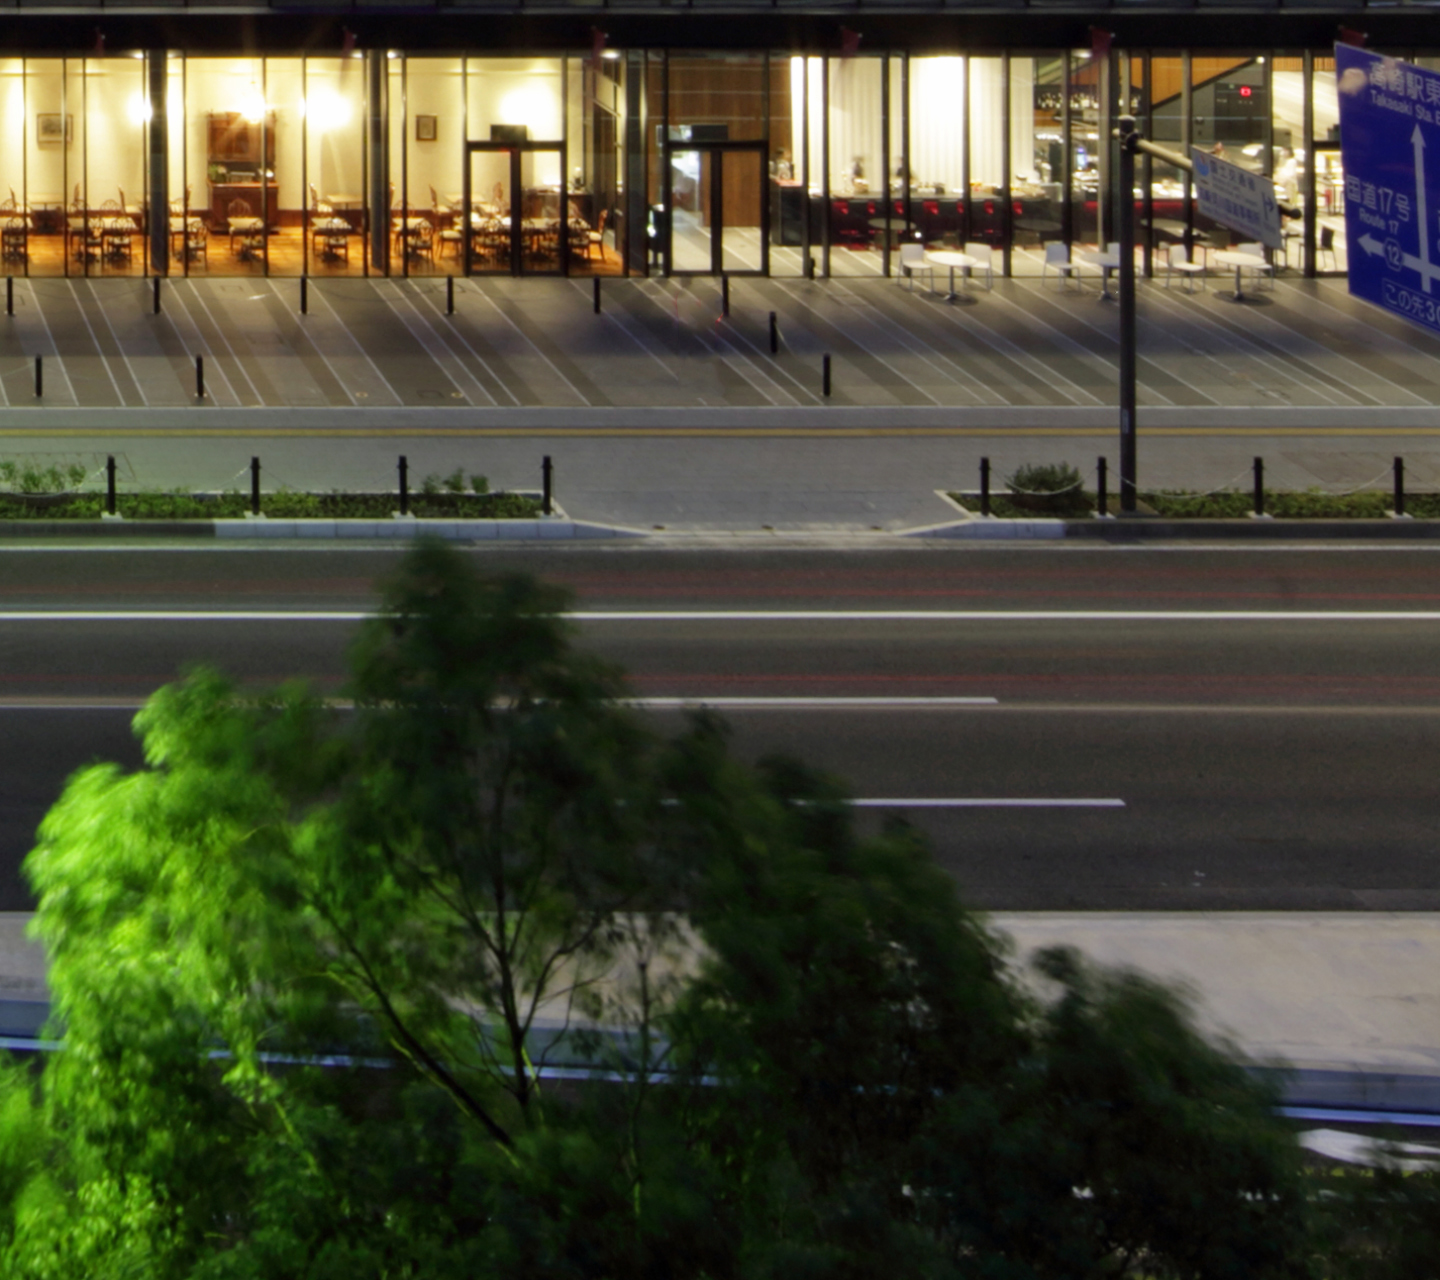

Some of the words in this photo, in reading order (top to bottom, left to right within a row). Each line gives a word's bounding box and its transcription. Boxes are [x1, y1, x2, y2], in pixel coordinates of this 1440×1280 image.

[1370, 90, 1413, 117] Takasaki
[1345, 174, 1411, 222] 国道17号
[1358, 207, 1386, 231] Route
[1388, 219, 1399, 236] 17
[1387, 243, 1401, 266] 12
